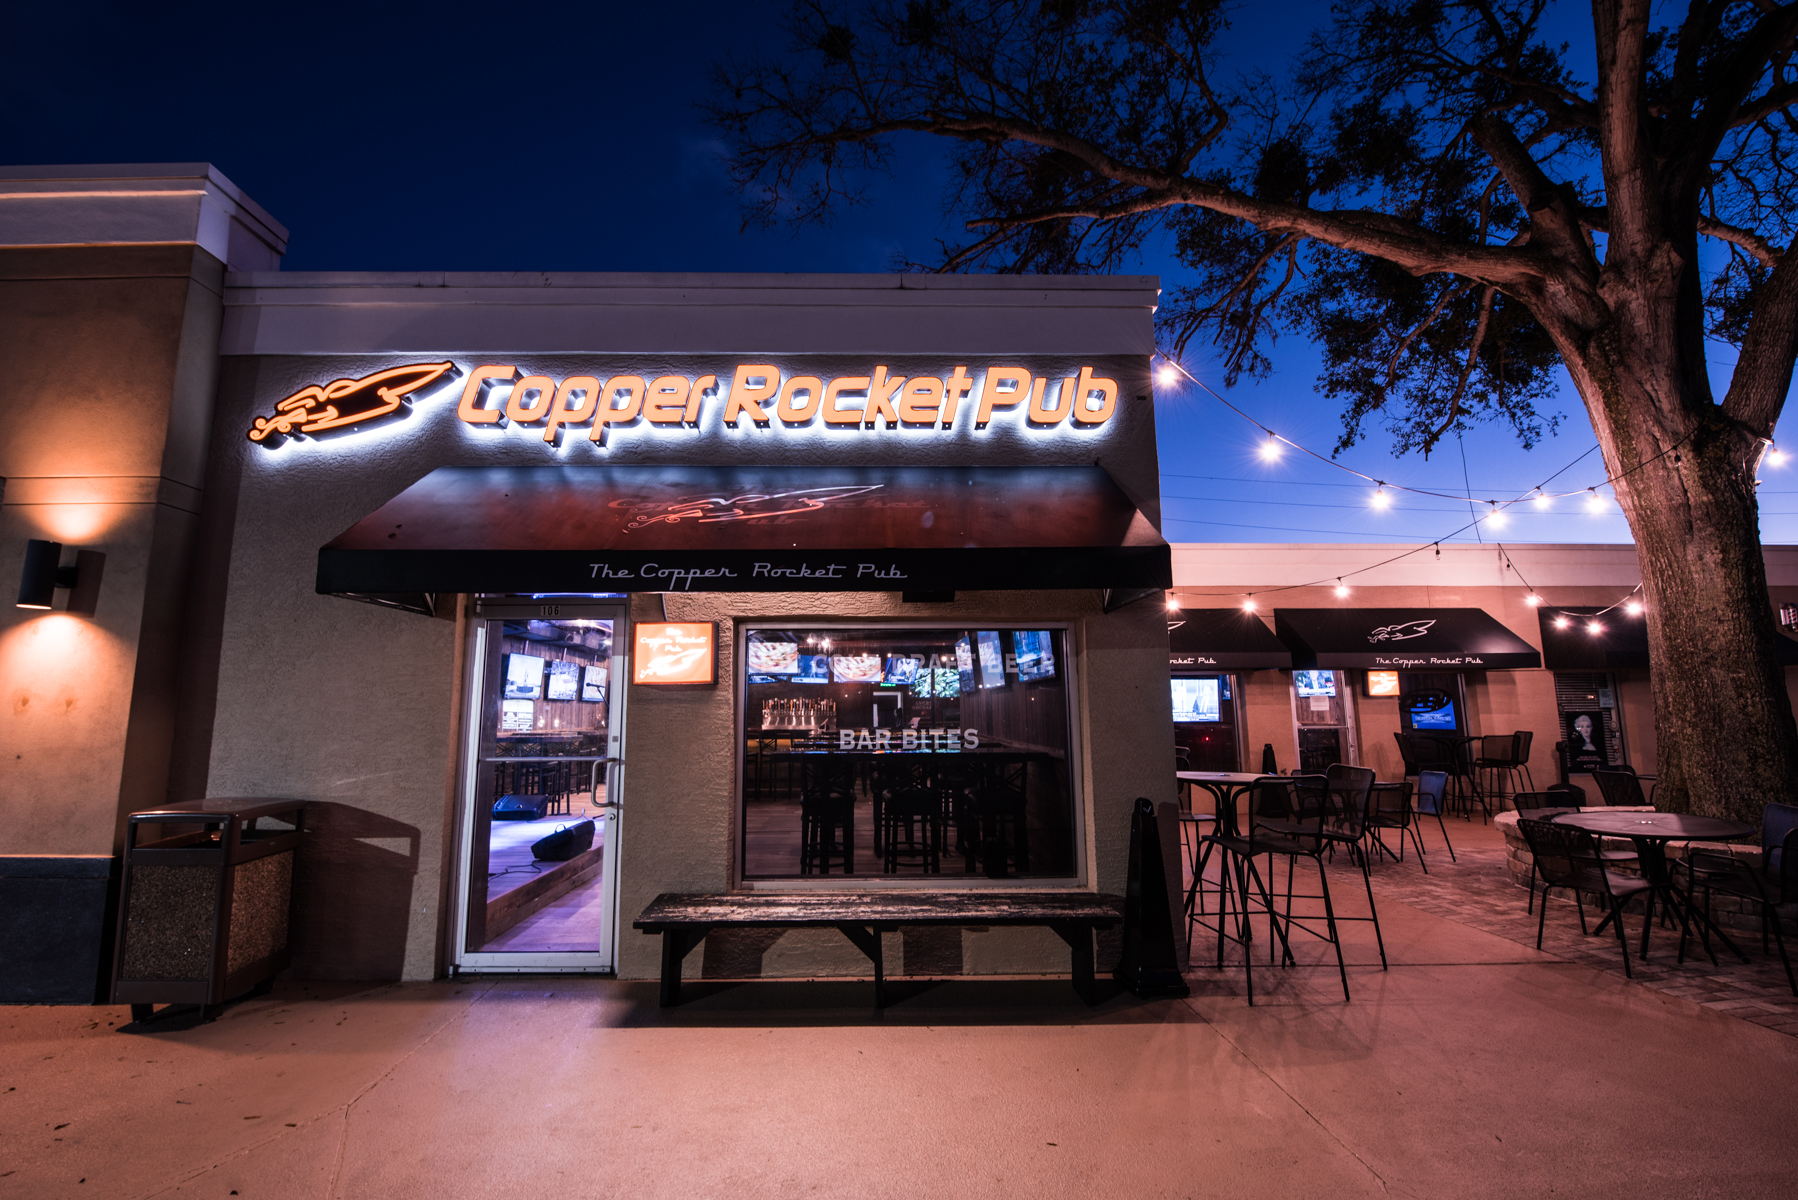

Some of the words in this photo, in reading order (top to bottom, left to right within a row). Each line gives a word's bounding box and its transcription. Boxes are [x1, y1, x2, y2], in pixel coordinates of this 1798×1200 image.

[457, 364, 717, 442] Copper
[723, 363, 974, 423] Rocket
[976, 365, 1118, 423] Pub
[589, 563, 635, 578] The
[640, 563, 738, 591] Copper
[752, 562, 847, 578] Rocket
[856, 563, 908, 579] Pub
[542, 605, 560, 616] 106
[1169, 657, 1195, 665] ocket
[1392, 657, 1427, 669] Copper
[839, 728, 892, 750] BAR
[902, 728, 980, 750] BITES
